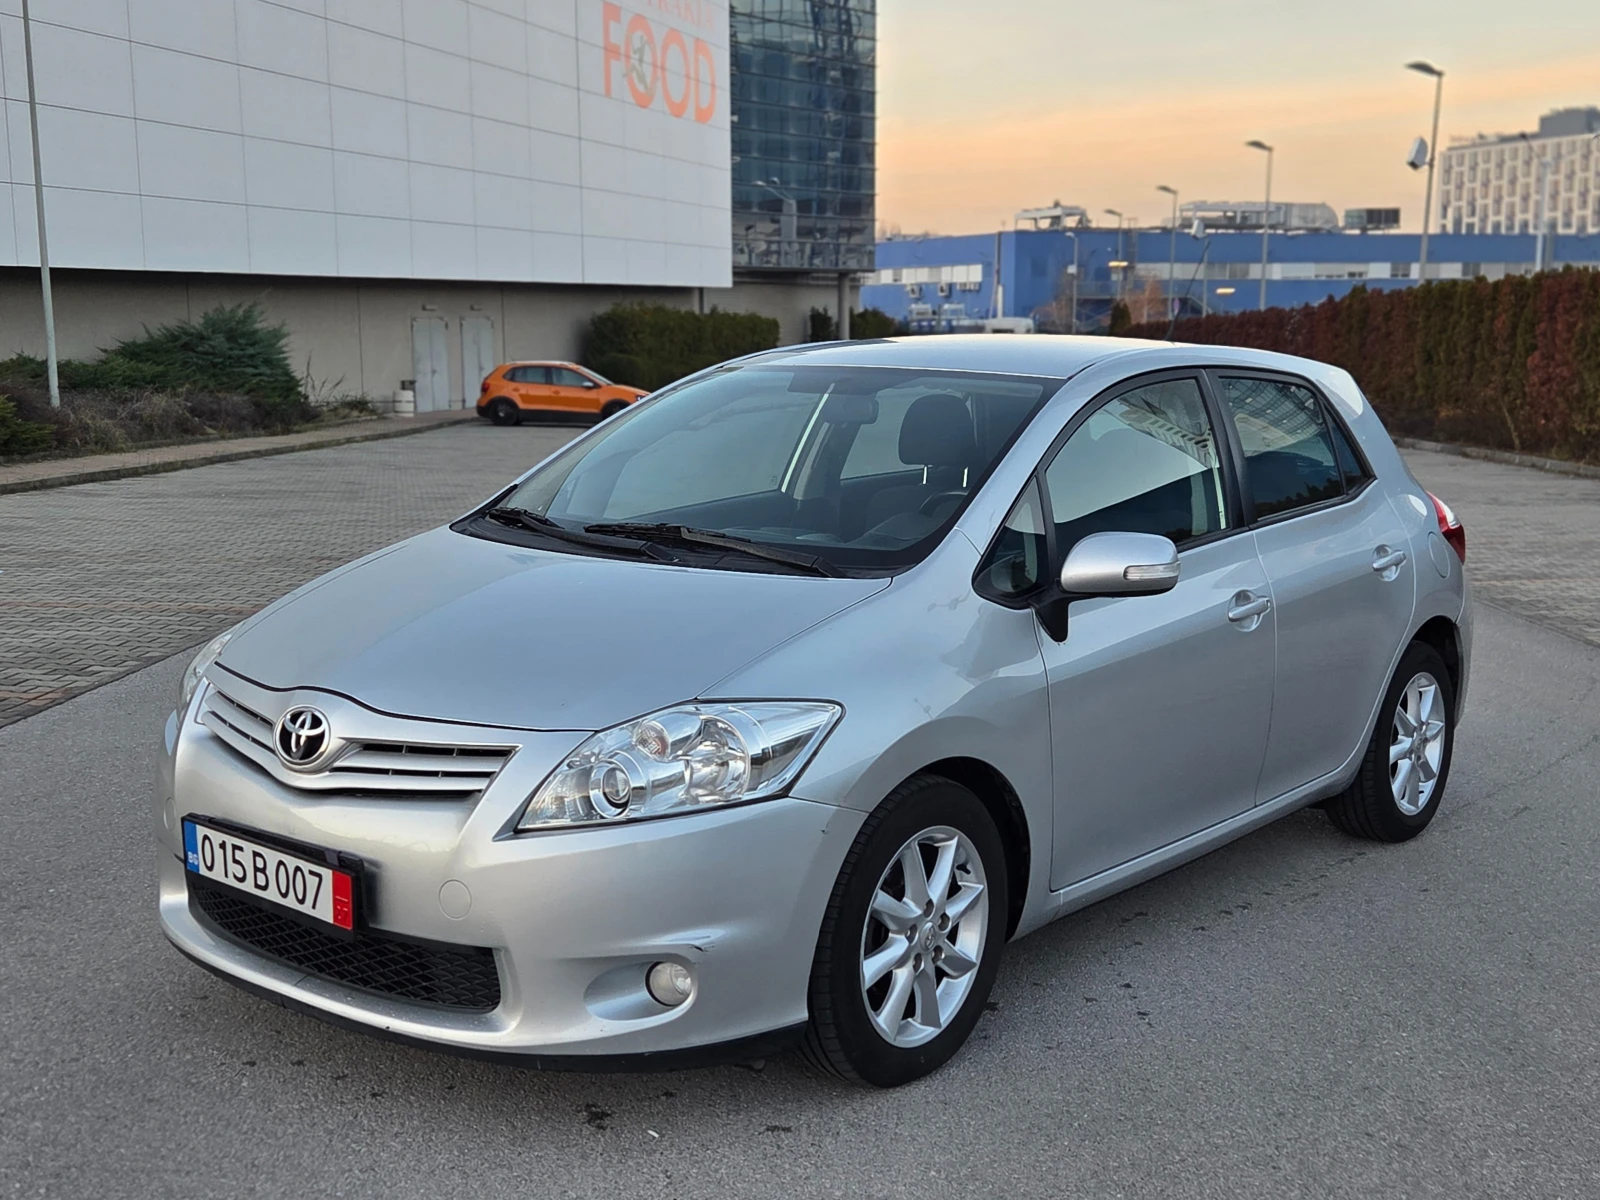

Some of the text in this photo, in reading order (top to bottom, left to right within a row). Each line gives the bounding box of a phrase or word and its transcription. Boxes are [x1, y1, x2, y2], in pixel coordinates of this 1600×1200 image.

[646, 0, 714, 31] AKIA
[602, 2, 715, 124] FOOD
[187, 851, 199, 865] BG
[201, 834, 323, 910] 015B007
